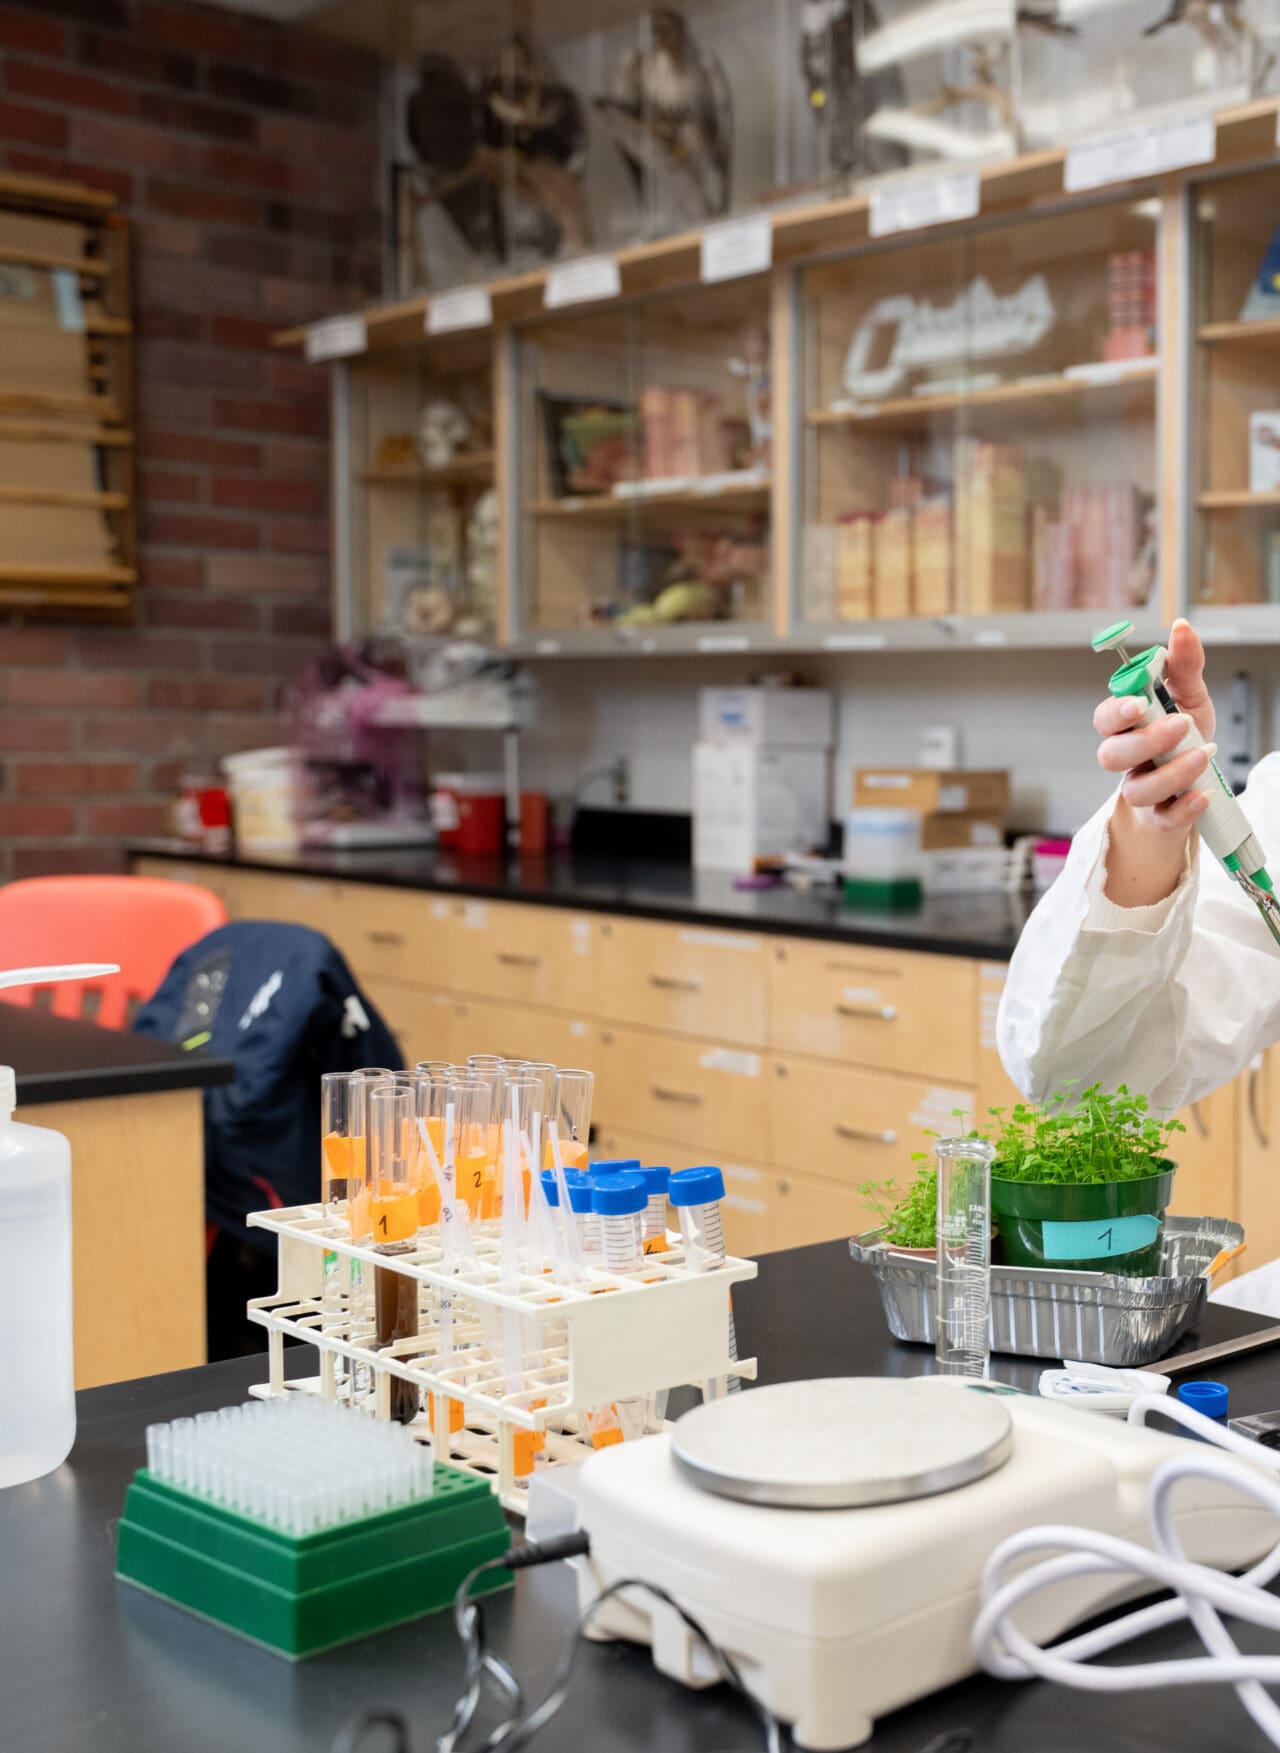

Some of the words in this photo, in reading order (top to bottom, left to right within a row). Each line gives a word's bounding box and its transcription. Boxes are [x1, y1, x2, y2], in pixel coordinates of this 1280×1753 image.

[473, 1170, 482, 1188] 2
[378, 1214, 388, 1235] 1
[1097, 1227, 1113, 1252] 1
